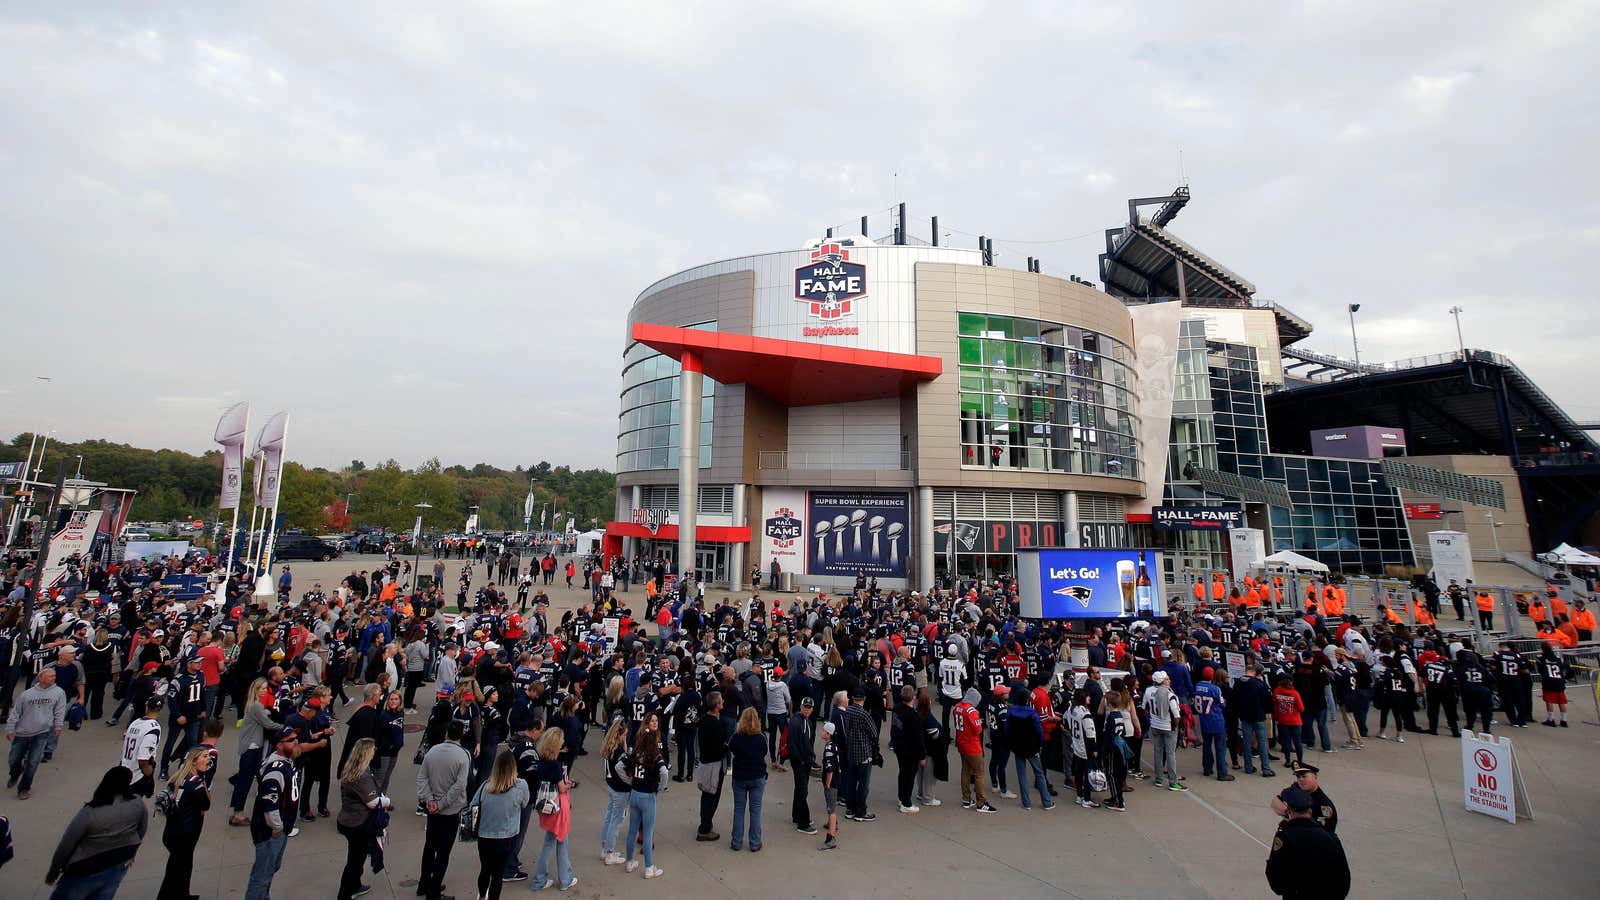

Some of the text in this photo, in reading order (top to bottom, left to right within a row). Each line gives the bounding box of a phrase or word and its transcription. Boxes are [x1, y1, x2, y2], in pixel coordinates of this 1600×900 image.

[813, 267, 847, 276] HALL
[799, 276, 861, 296] FAME
[803, 326, 859, 338] Raytheon
[1157, 511, 1194, 520] HALL
[1201, 511, 1239, 521] FAME
[768, 525, 800, 537] FAME
[992, 524, 1124, 548] PRO SHOP
[1049, 567, 1100, 580] Let's Go!
[1223, 632, 1231, 644] 11
[934, 645, 944, 659] 12
[1007, 666, 1021, 680] 87
[1028, 661, 1038, 675] 12
[1501, 659, 1519, 676] 12
[1546, 662, 1562, 679] 12
[762, 669, 776, 683] 12
[891, 670, 904, 686] 12
[944, 670, 956, 686] 11
[989, 674, 1004, 691] 12
[1427, 668, 1444, 684] 87
[1464, 671, 1483, 683] 12
[188, 682, 202, 703] 11
[1392, 678, 1403, 691] 12
[632, 703, 647, 721] 12
[1194, 695, 1214, 715] 87
[125, 737, 137, 761] 12
[634, 764, 645, 779] 12
[1477, 772, 1498, 791] NO
[1470, 787, 1507, 803] RE-ENTRY TO
[1470, 795, 1509, 812] THE STADIUM
